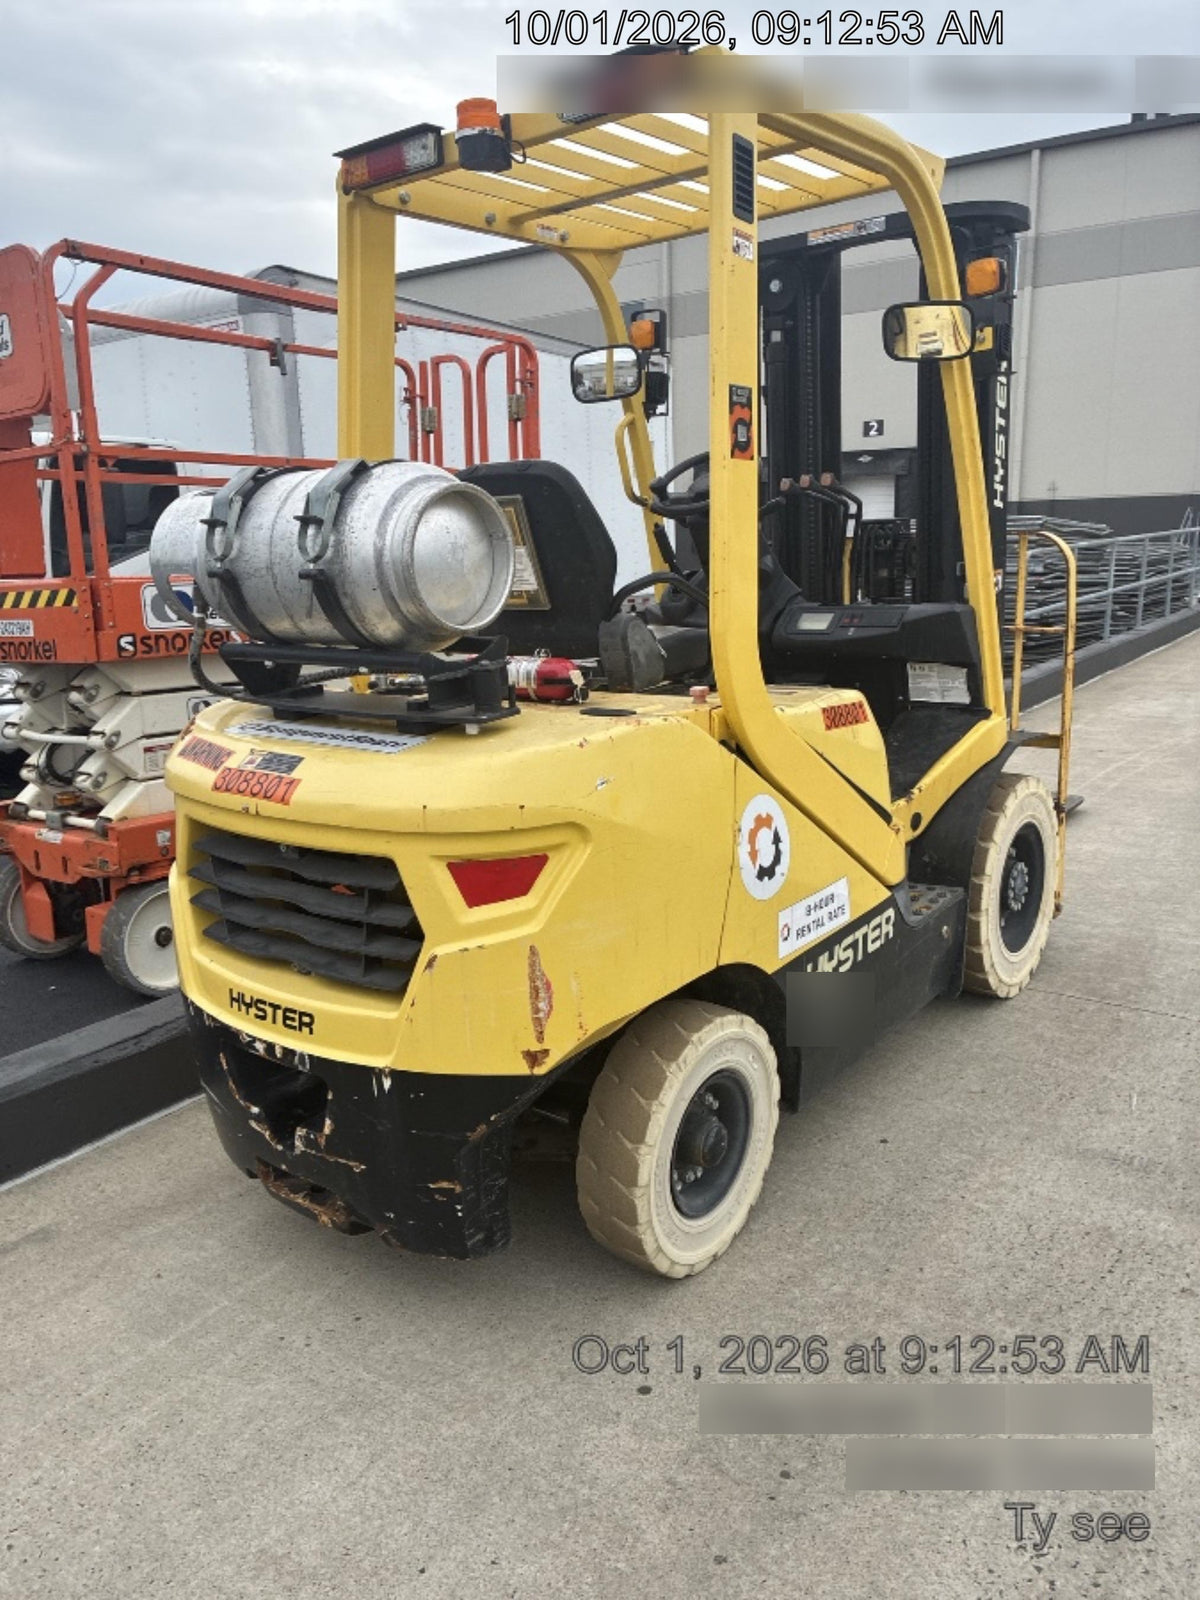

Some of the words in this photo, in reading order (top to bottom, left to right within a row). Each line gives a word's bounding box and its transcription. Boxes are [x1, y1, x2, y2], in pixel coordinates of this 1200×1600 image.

[868, 421, 880, 436] 2
[0, 638, 58, 660] snorkel
[140, 630, 231, 655] snoe
[213, 767, 296, 804] 308801
[795, 915, 826, 941] RENTAL
[828, 904, 846, 921] RATE
[229, 988, 315, 1035] HYSTER
